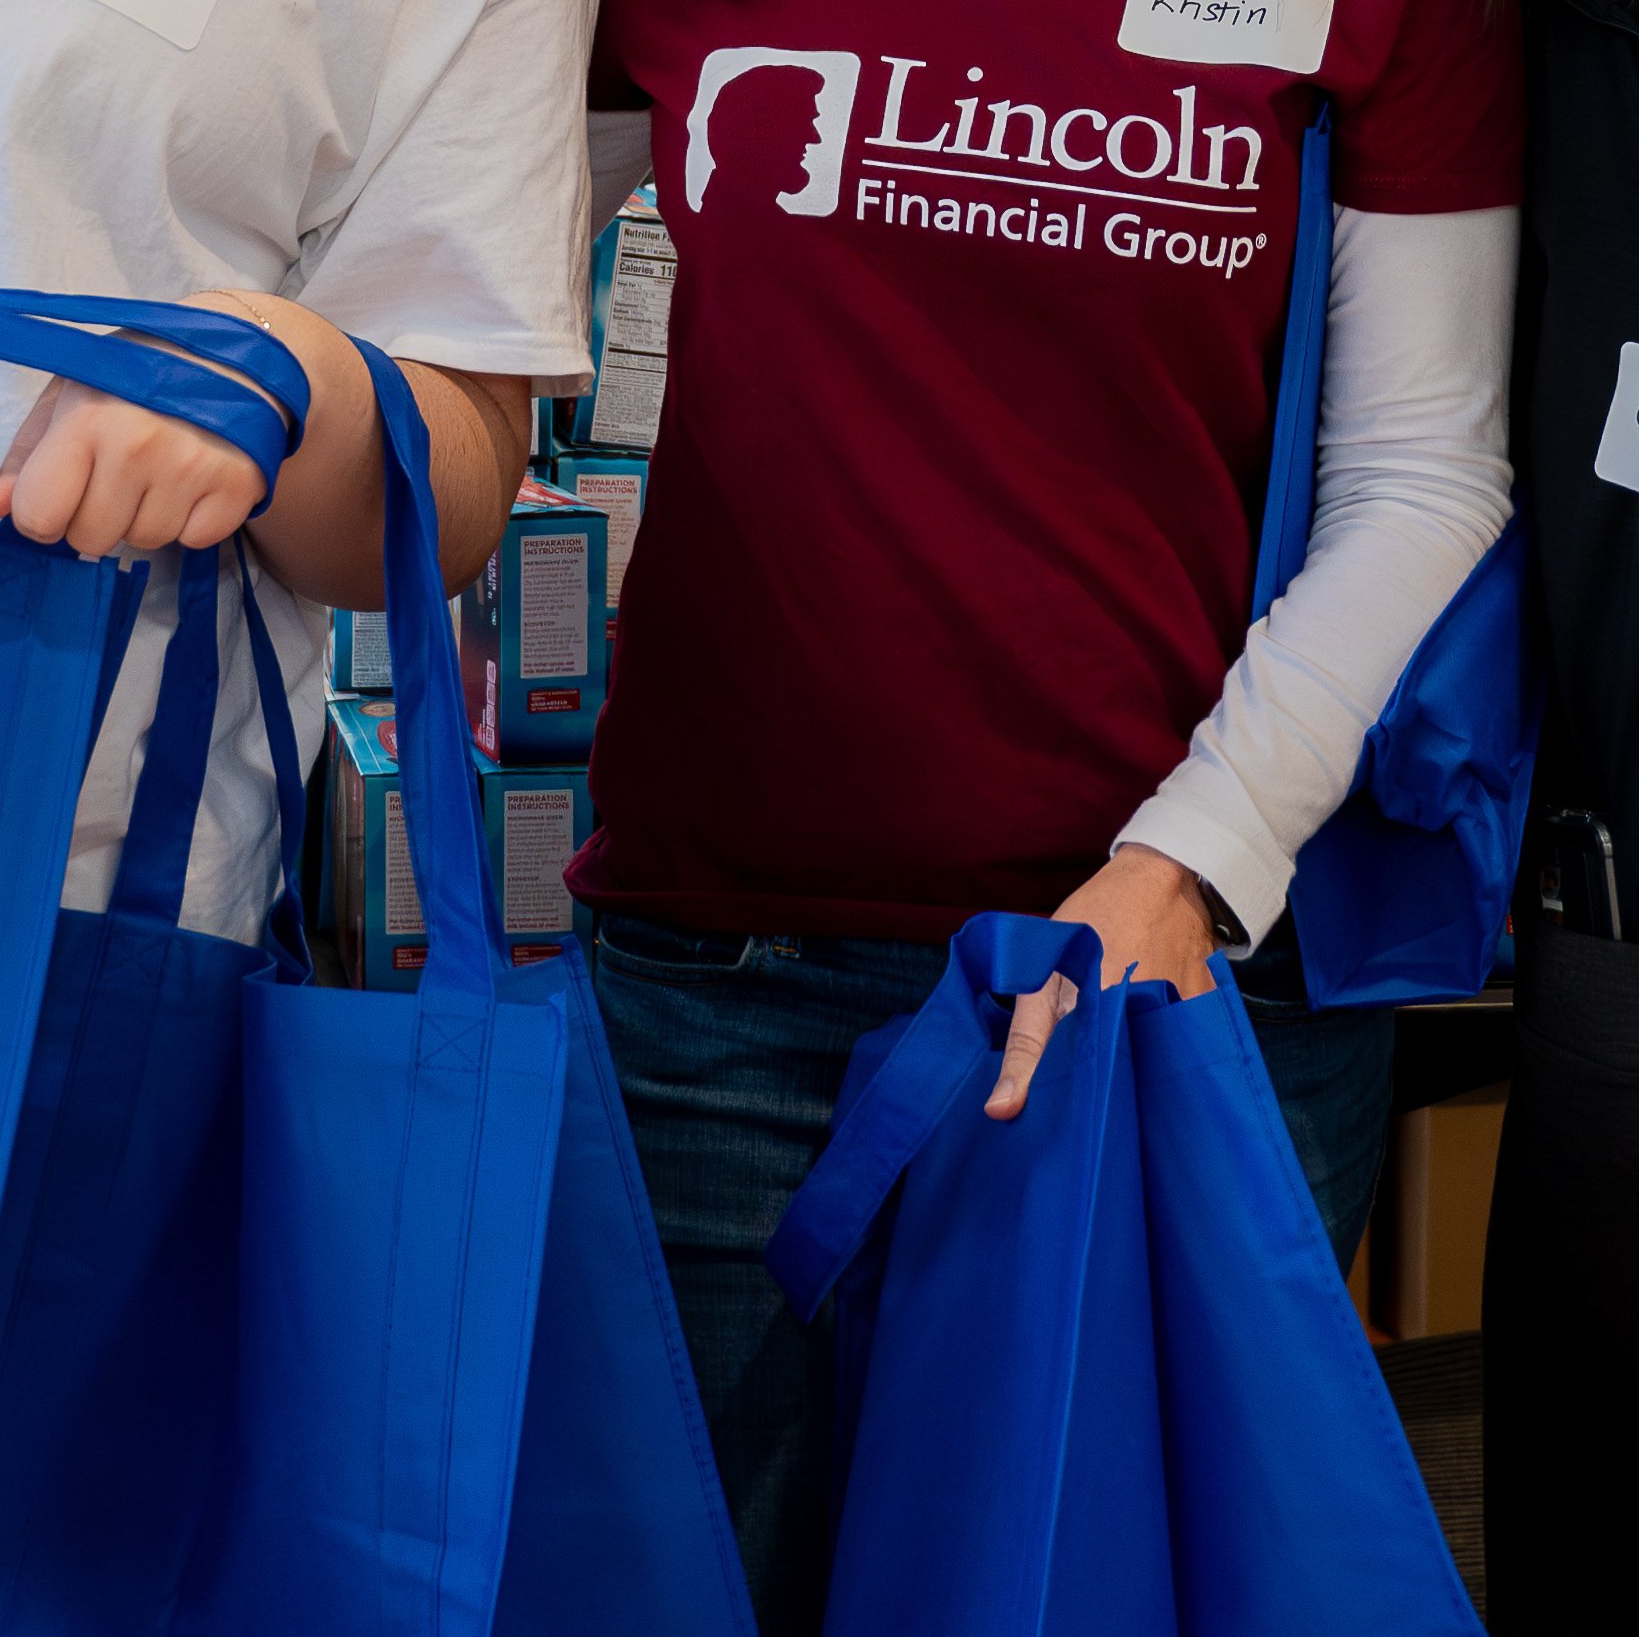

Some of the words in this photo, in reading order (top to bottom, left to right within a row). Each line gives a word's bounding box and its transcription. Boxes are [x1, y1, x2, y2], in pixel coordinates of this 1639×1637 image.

[864, 54, 1263, 192] Lincoln
[856, 178, 1085, 250] Financial
[624, 228, 660, 241] Nutrition
[619, 262, 655, 275] Calories
[580, 486, 638, 494] INSTRUCTIONS
[524, 538, 582, 548] PREPARATION
[524, 546, 585, 556] INSTRUCTIONS
[507, 794, 567, 803] PREPARATION
[508, 801, 570, 811] INSTRUCTIONS
